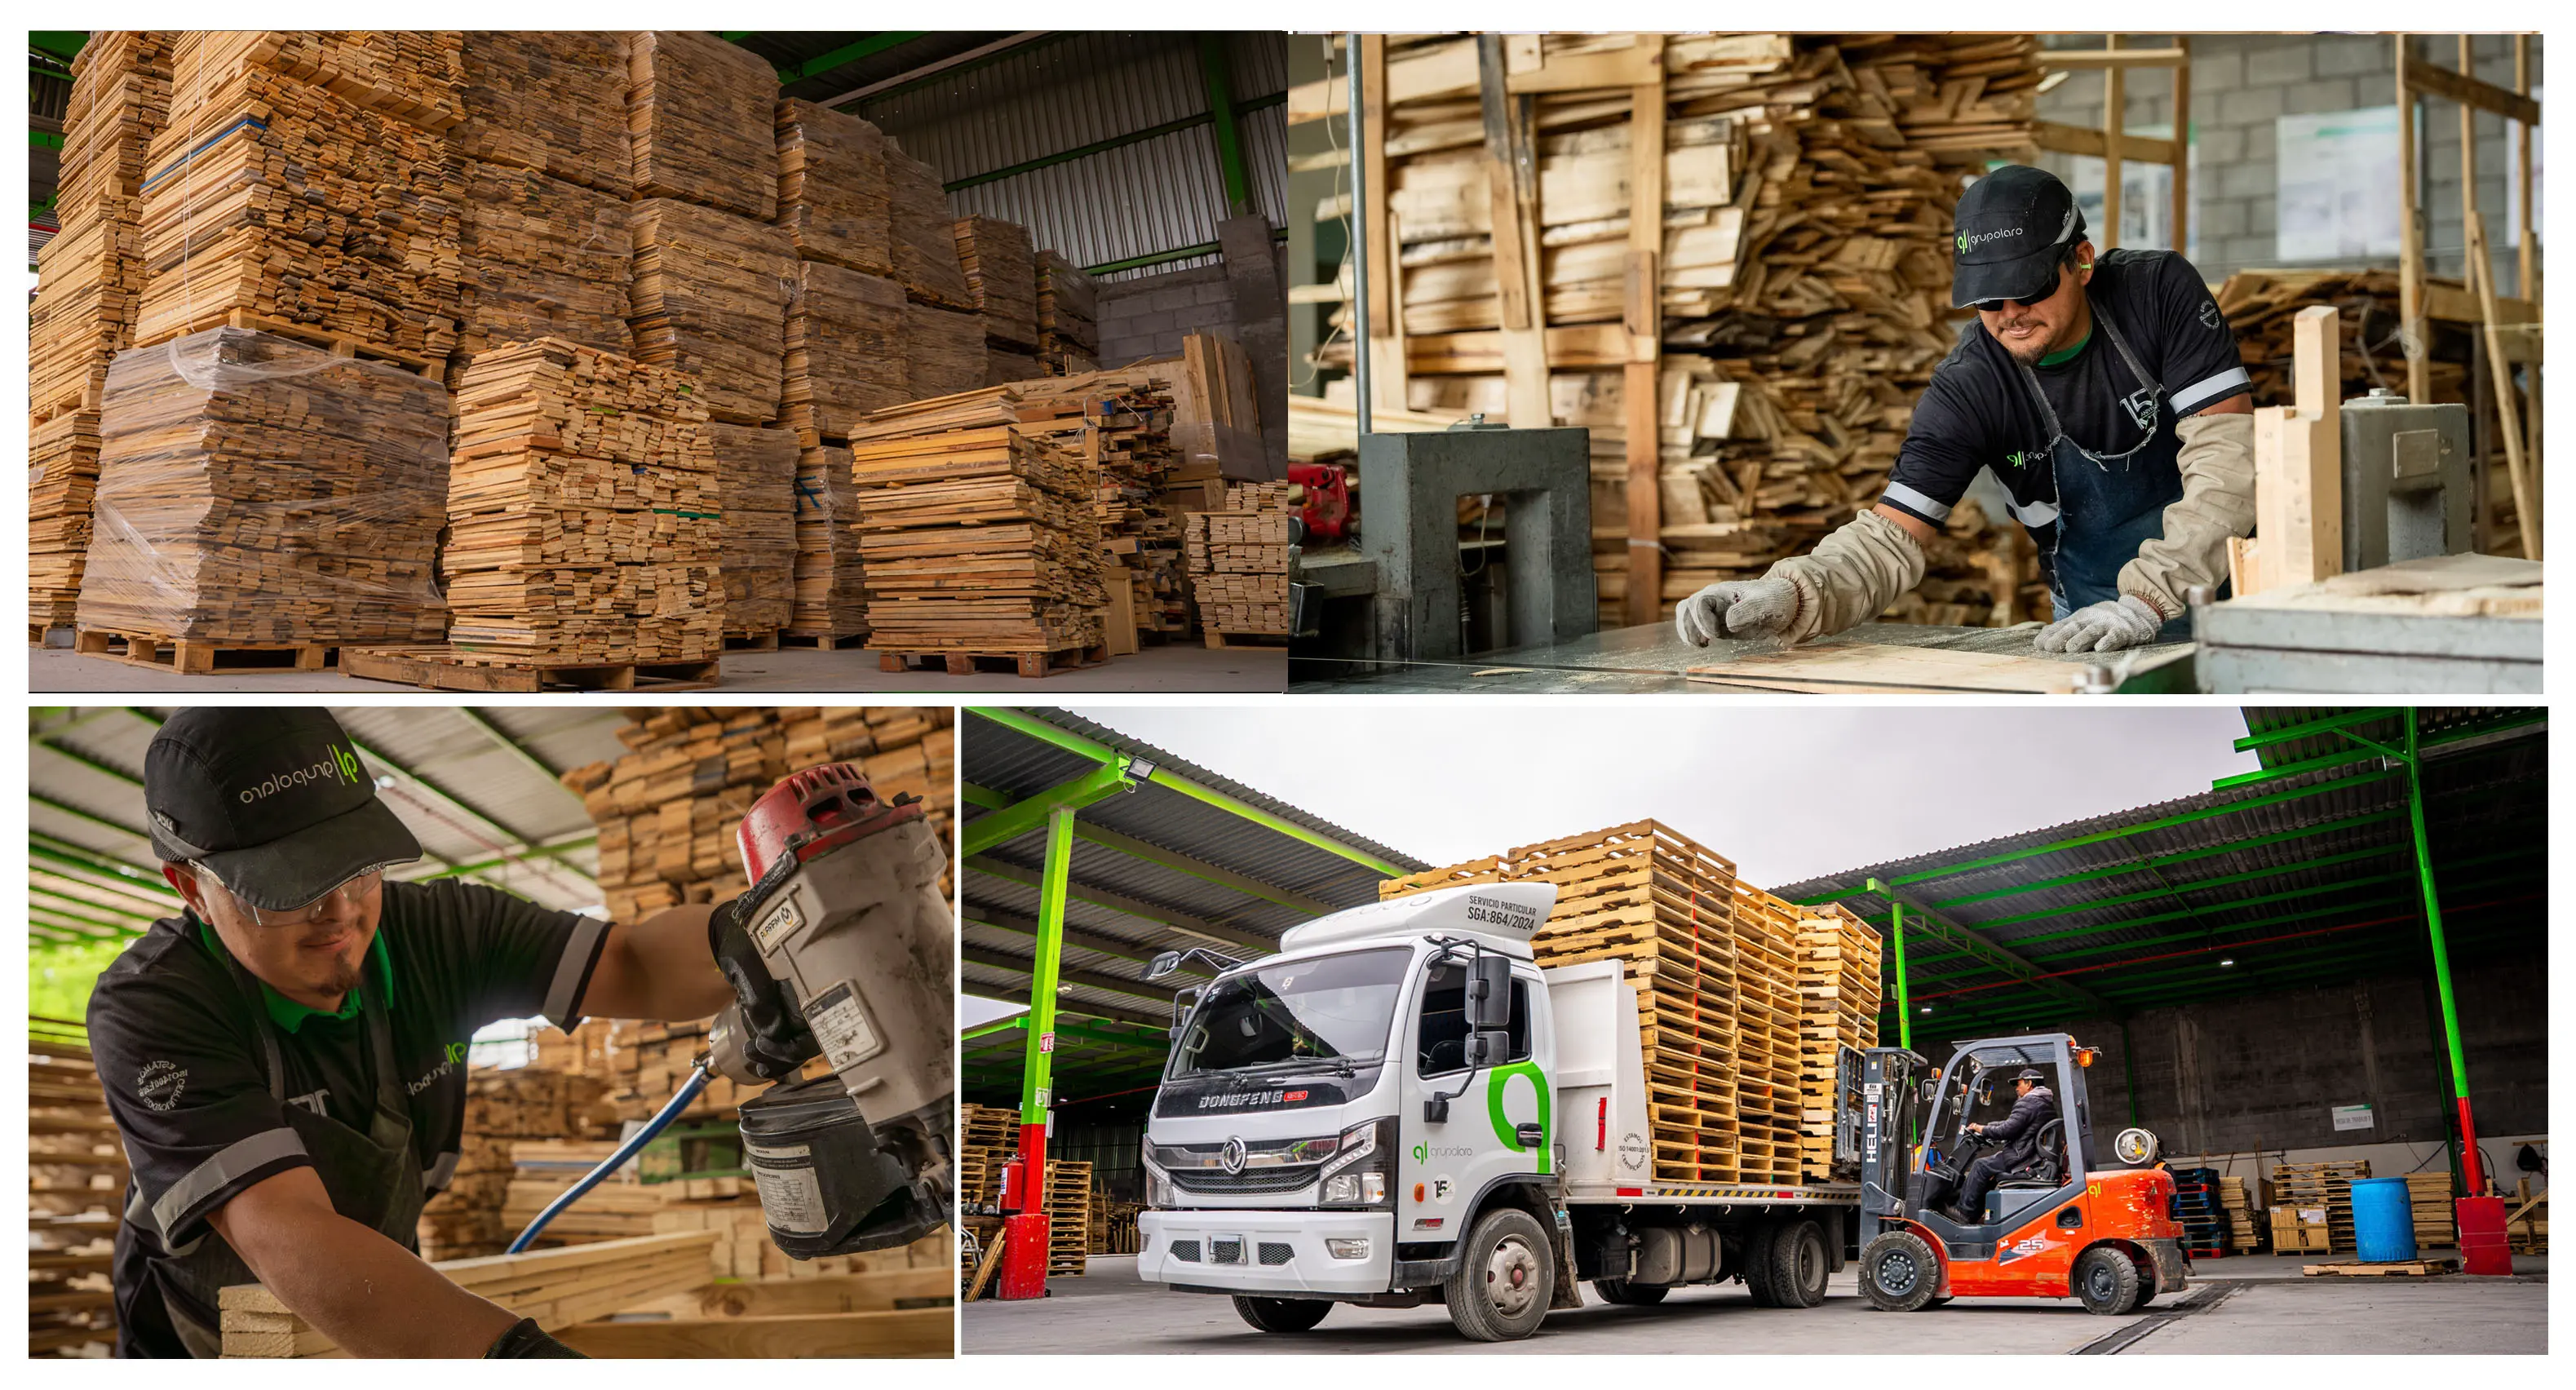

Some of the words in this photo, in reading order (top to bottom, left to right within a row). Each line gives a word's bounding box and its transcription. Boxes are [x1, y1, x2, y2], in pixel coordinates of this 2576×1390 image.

[1971, 228, 2023, 246] grupolaro
[1469, 895, 1499, 909] SERVICIO
[1501, 901, 1537, 916] PARTICULAR
[1468, 906, 1535, 931] SGA:864/2024
[1198, 1090, 1283, 1108] DONGFENG
[1866, 1122, 1878, 1163] HELI
[1430, 1146, 1473, 1159] grupolaro
[2019, 1239, 2044, 1251] 25
